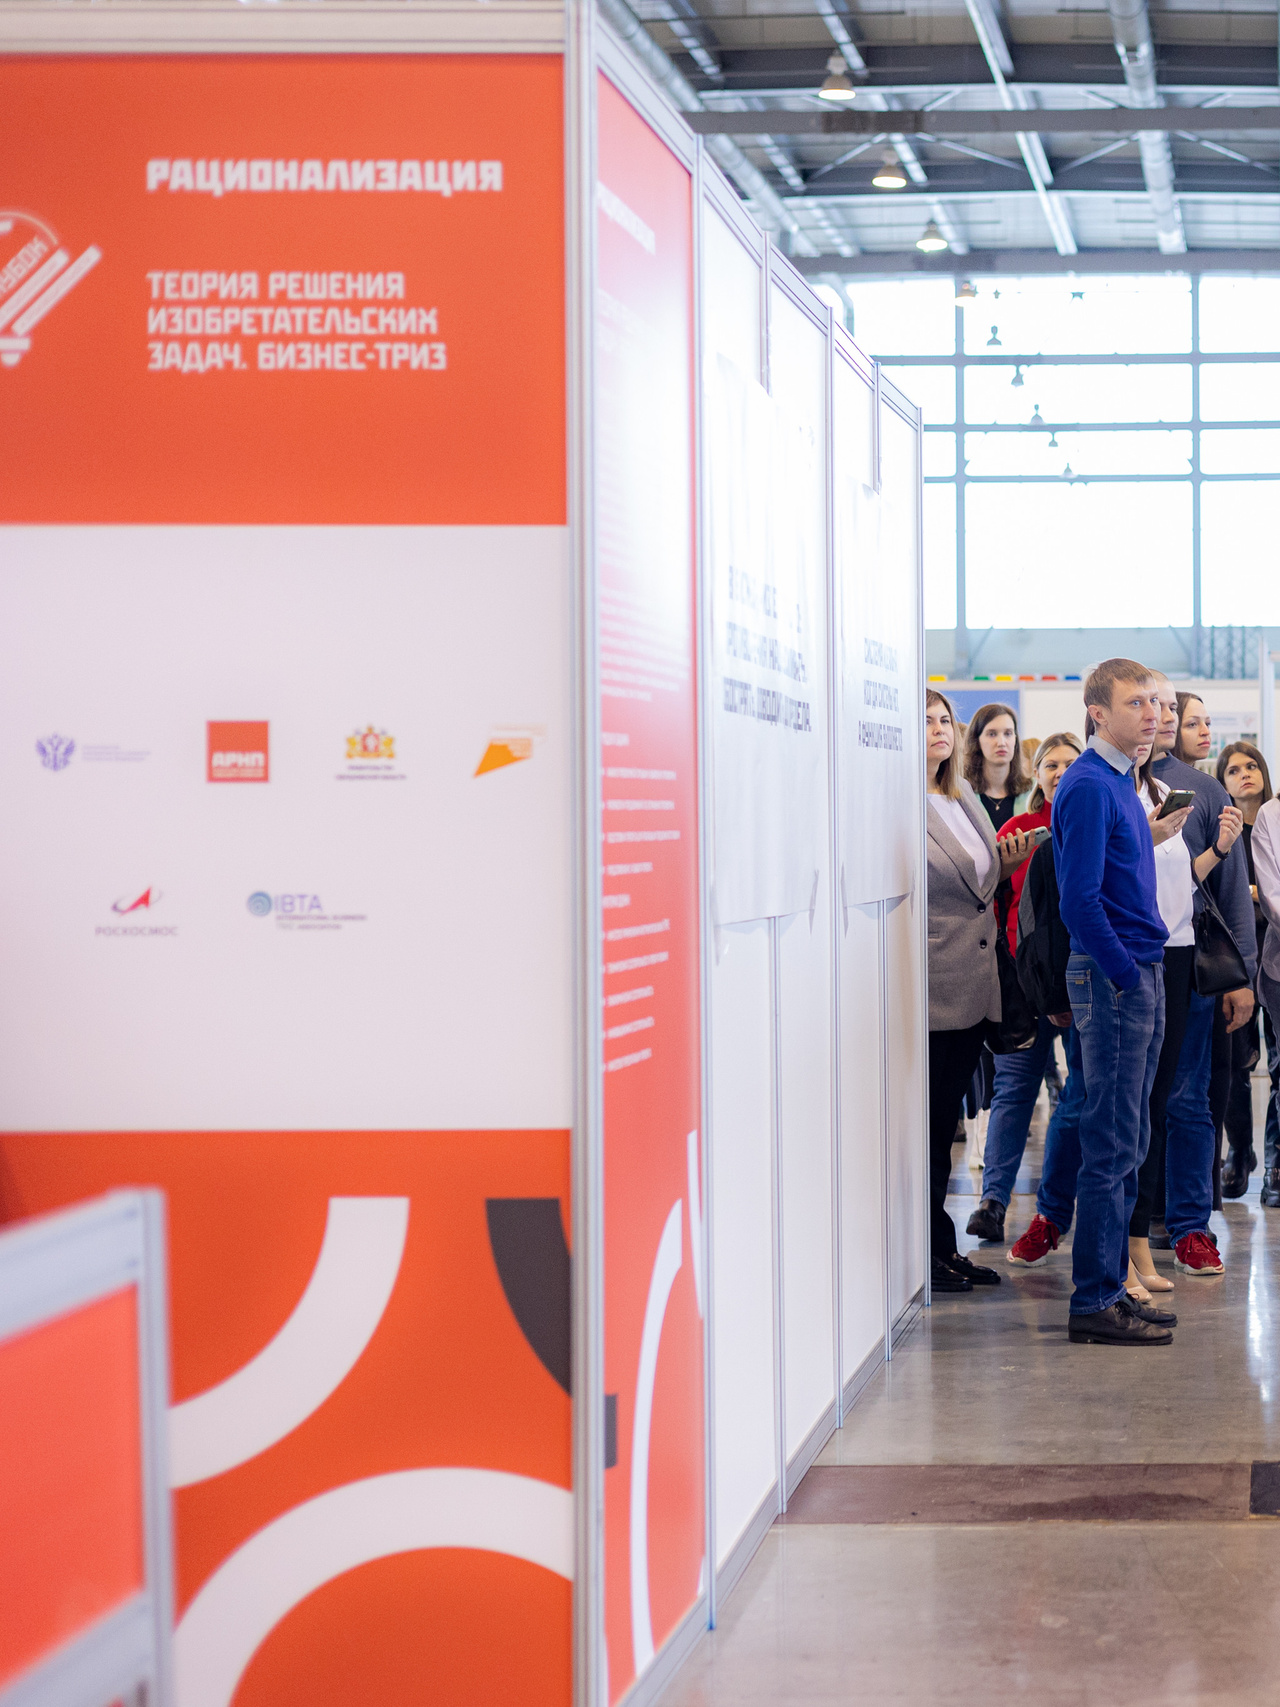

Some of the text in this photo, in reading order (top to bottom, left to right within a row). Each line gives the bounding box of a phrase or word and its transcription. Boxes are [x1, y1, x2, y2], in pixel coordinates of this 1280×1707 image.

[146, 160, 502, 197] РАЦИОНАЛИЗАЦИЯ
[147, 271, 405, 299] ТЕОРИЯ РЕШЕНИЯ
[147, 307, 439, 335] ИЗОБРЕТАТЕЛЬСКИХ
[147, 341, 447, 373] ЗАДАЧ. БИЗНЕС-ТРИЗ
[211, 752, 265, 768] АРНП
[274, 893, 323, 913] IBTA
